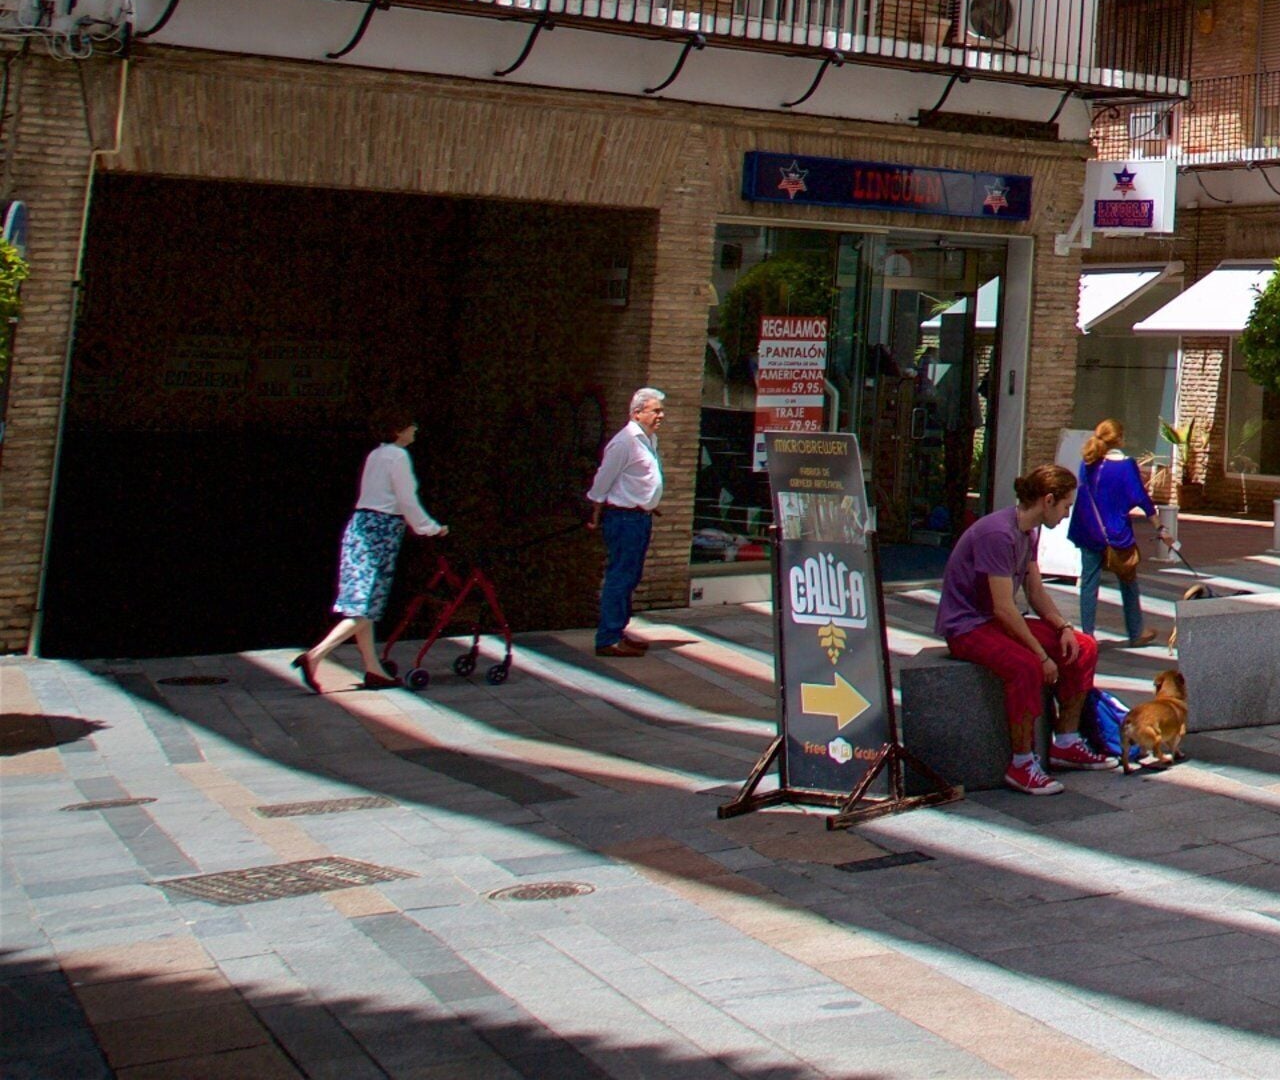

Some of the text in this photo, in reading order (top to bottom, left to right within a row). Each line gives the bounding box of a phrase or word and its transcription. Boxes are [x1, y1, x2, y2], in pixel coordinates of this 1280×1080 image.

[852, 169, 942, 204] LINCOLN
[761, 319, 827, 338] REGALAMOS
[766, 343, 826, 359] PANTALÓN
[760, 370, 824, 380] AMERICANA
[775, 407, 805, 418] TRAJE
[773, 439, 848, 456] MICROBREWERY
[789, 551, 867, 620] CALIFA
[803, 741, 827, 755] Free
